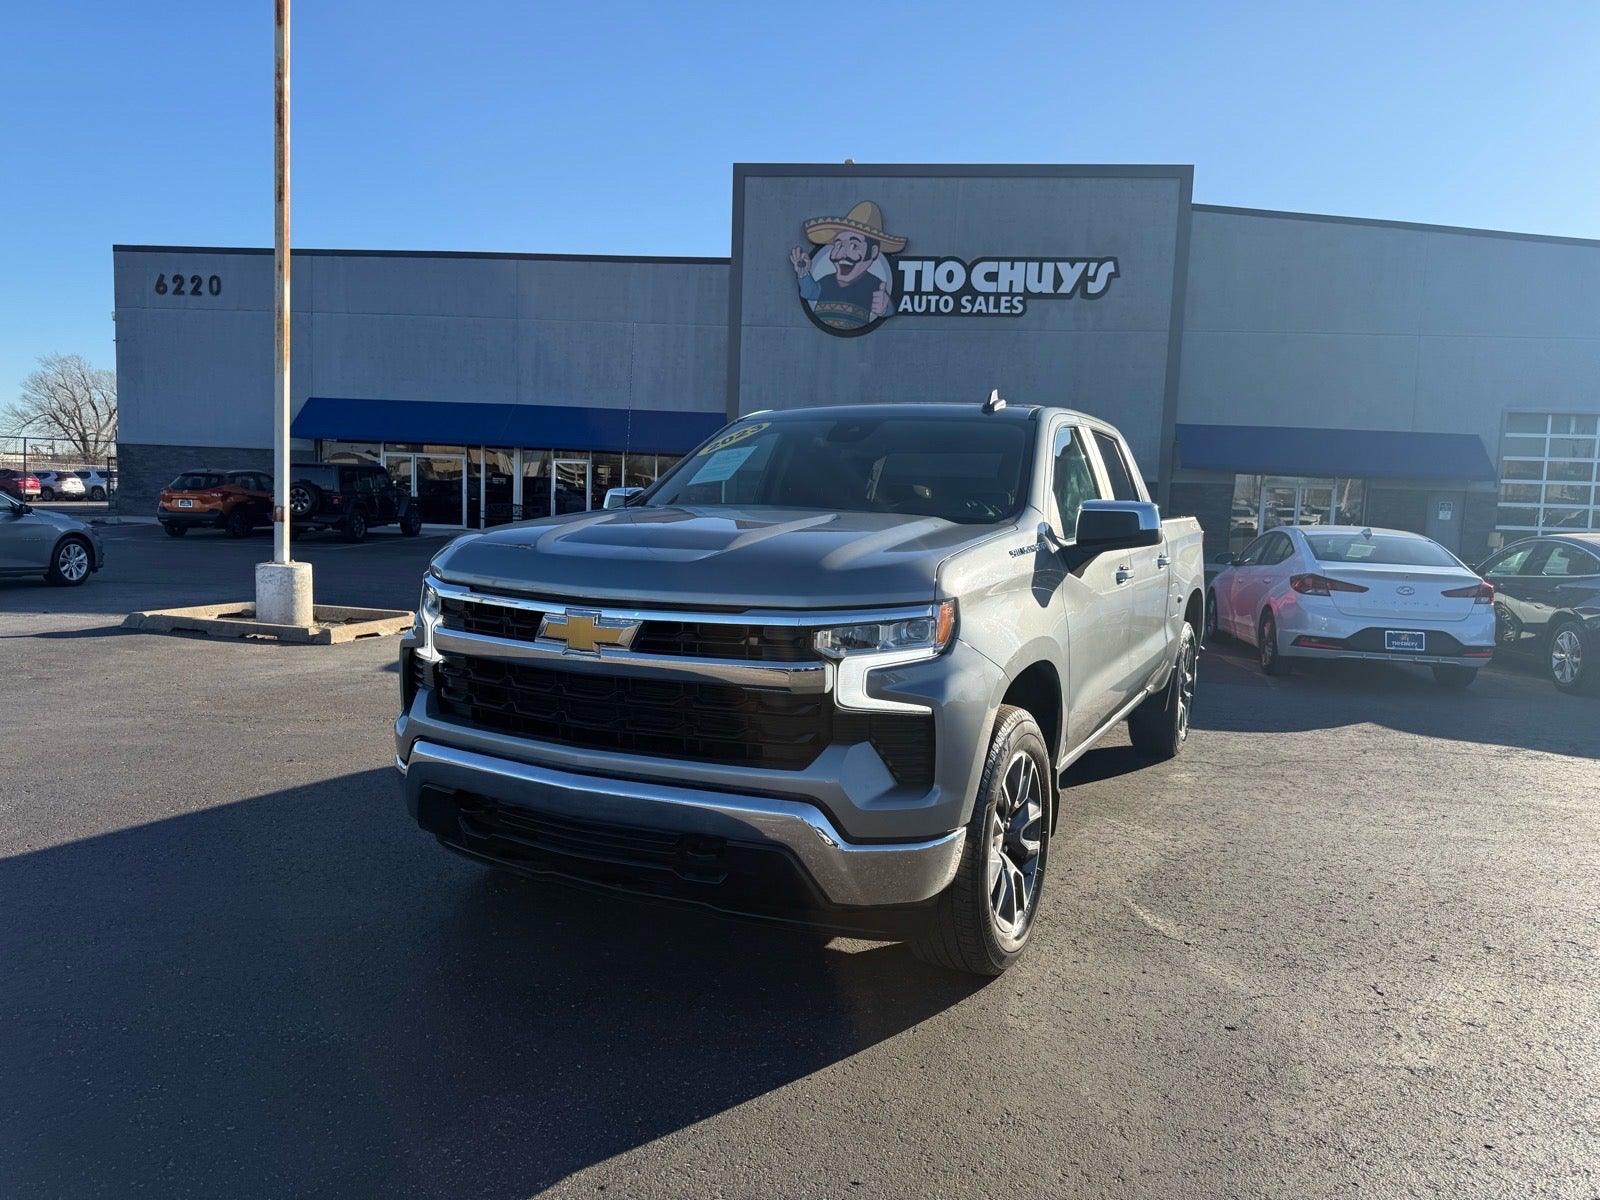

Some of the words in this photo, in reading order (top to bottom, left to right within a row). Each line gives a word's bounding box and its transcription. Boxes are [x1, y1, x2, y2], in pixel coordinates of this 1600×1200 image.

[154, 273, 222, 296] 6220
[898, 261, 966, 292] TIO
[970, 260, 1115, 294] CHUY'S
[898, 295, 954, 313] AUTO
[960, 295, 1024, 314] SALES
